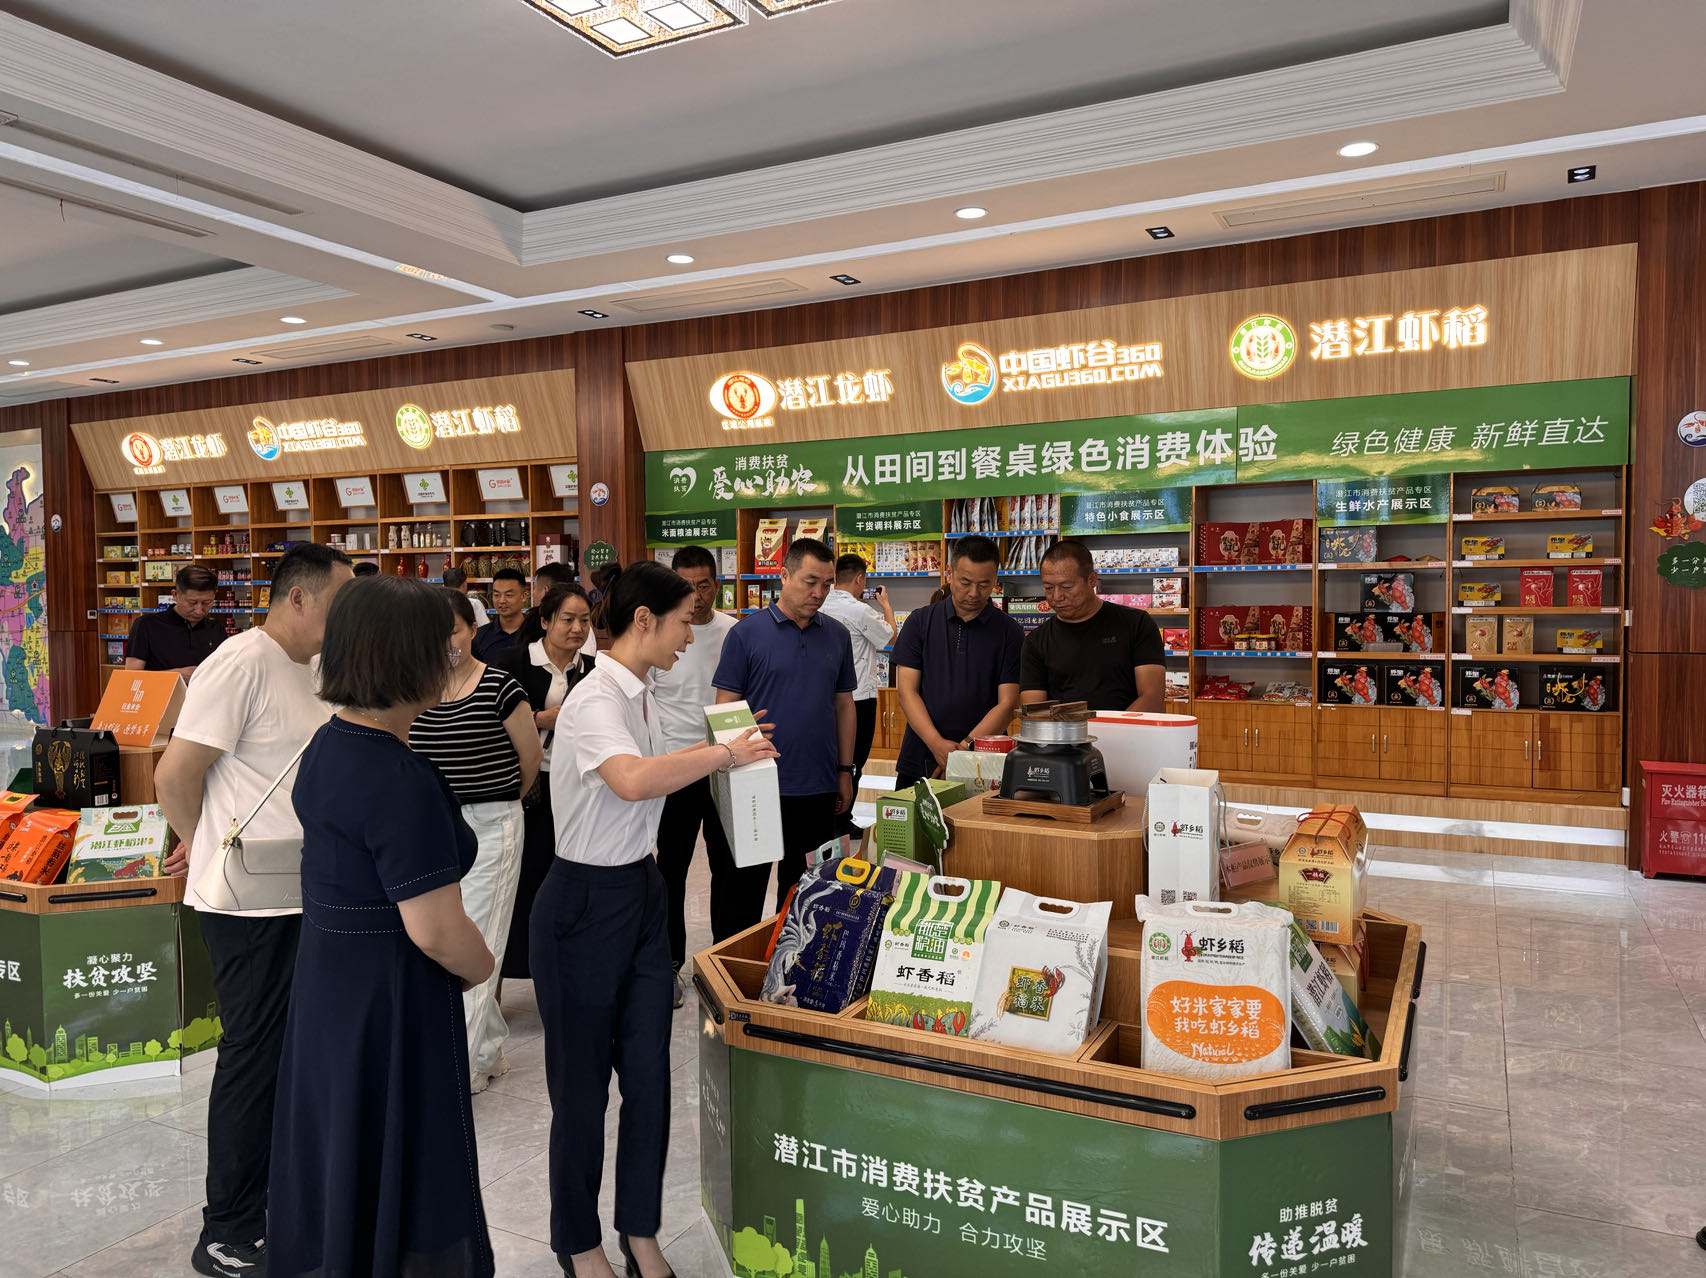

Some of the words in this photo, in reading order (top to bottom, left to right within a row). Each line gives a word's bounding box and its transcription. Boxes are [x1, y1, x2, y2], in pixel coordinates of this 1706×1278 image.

[1310, 306, 1489, 360] 潜江虾稻
[1000, 340, 1164, 376] 中国虾谷360
[1002, 363, 1164, 392] XIAGU360.COM
[776, 369, 894, 411] 潜江龙虾
[277, 417, 364, 441] 中国虾谷360
[430, 404, 522, 439] 潜江虾稻
[159, 432, 228, 461] 潜江龙虾
[1330, 424, 1457, 457] 绿色健康
[1470, 415, 1609, 451] 新鲜直达
[735, 453, 789, 471] 消费扶贫
[842, 423, 1278, 487] 从田间到餐桌绿色消费体验
[708, 464, 818, 500] 爱心助农
[1335, 486, 1433, 498] 潜江市消费扶贫产品专区
[856, 510, 921, 520] 潜江市消费扶贫产品专区
[1084, 509, 1165, 523] 特色小食展示区
[1335, 498, 1433, 513] 生鲜水产展示区
[661, 518, 717, 527] 潜江市消费扶贫产品专区
[661, 527, 718, 537] 米面粮油展示区
[855, 519, 922, 531] 干货调料展示区
[1661, 784, 1706, 799] 灭火器箱
[1659, 830, 1679, 843] 火警
[1199, 937, 1245, 954] 虾乡稻
[86, 952, 133, 965] 凝心聚力
[62, 961, 158, 989] 扶贫攻坚
[896, 965, 956, 986] 虾香稻
[1016, 975, 1048, 994] 虾香
[112, 985, 148, 996] 少一户贫困
[1013, 992, 1044, 1012] 稻米
[1170, 995, 1262, 1020] 好米家家要
[1174, 1016, 1260, 1039] 我吃虾乡稻
[1190, 1041, 1235, 1058] Natural
[773, 1131, 1171, 1254] 潜江市消费扶贫产品展示区
[1279, 1198, 1338, 1223] 助推脱贫
[860, 1196, 942, 1235] 爱心助力
[959, 1221, 1048, 1261] 合力攻坚
[1248, 1213, 1369, 1267] 传递温暖
[1311, 1254, 1356, 1272] 少一户贫困
